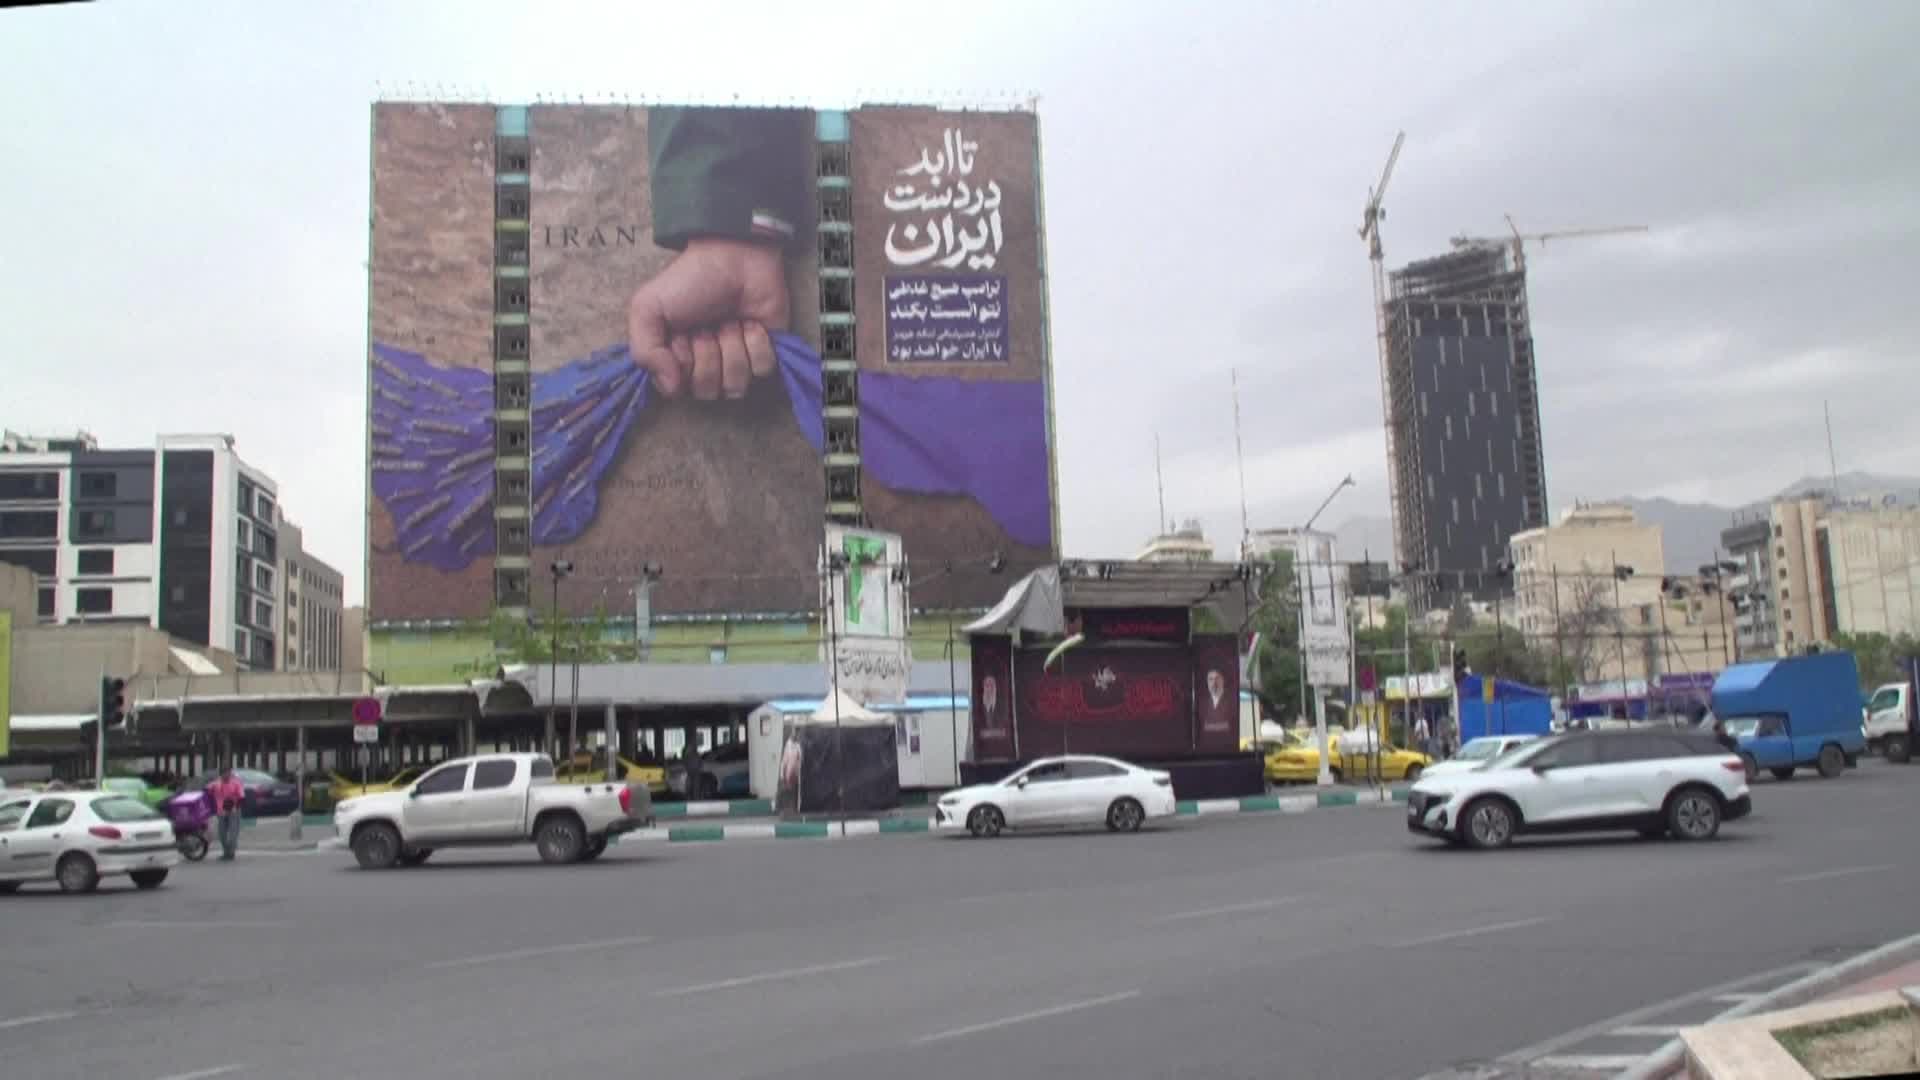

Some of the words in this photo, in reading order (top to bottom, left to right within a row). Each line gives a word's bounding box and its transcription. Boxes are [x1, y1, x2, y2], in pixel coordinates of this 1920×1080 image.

[895, 127, 955, 188] ابد
[955, 127, 979, 175] تا
[883, 178, 971, 212] دست
[960, 178, 1002, 216] در
[544, 224, 637, 249] IRAN
[884, 207, 1004, 270] ایران
